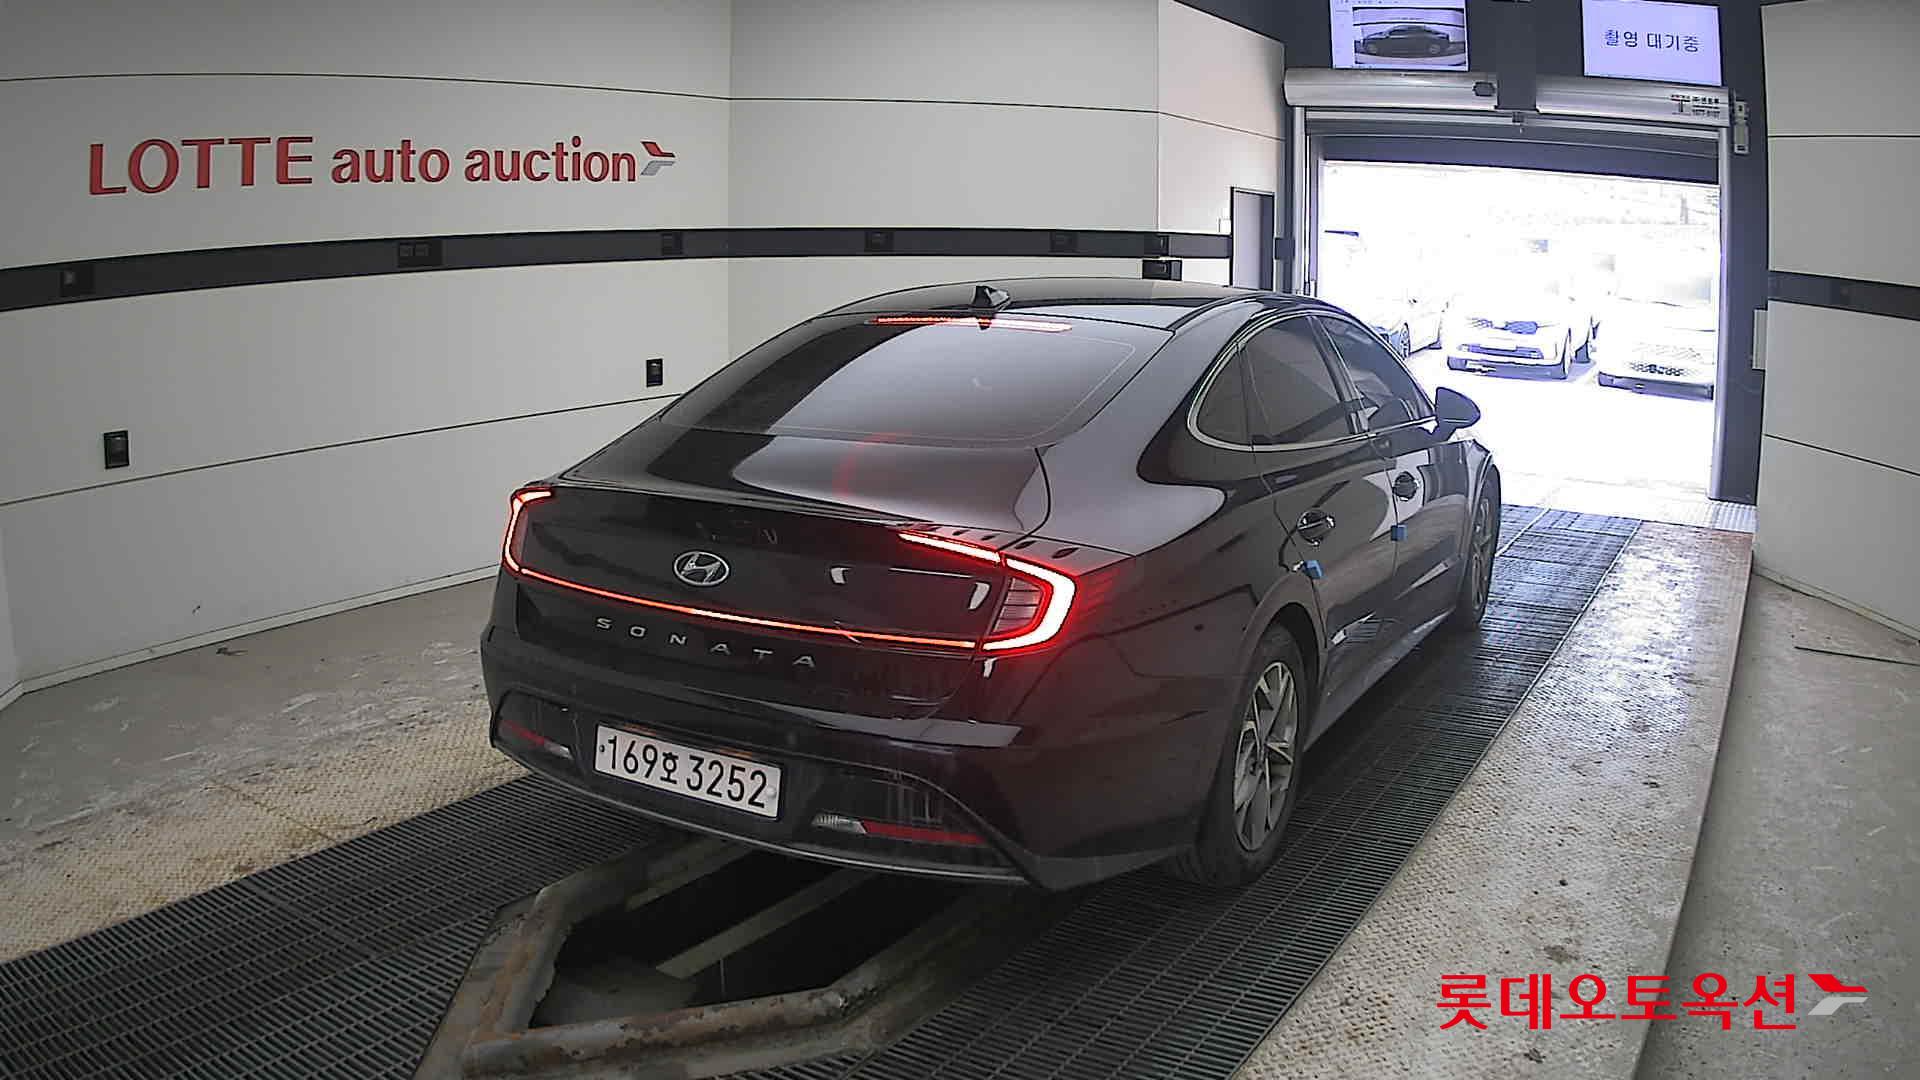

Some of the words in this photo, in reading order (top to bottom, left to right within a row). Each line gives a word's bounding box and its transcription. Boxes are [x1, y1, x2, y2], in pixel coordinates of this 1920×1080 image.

[1646, 32, 1699, 53] 대기중
[89, 136, 313, 195] LOTTE
[331, 139, 450, 184] auto
[463, 135, 638, 183] auction
[596, 617, 816, 668] SONATA
